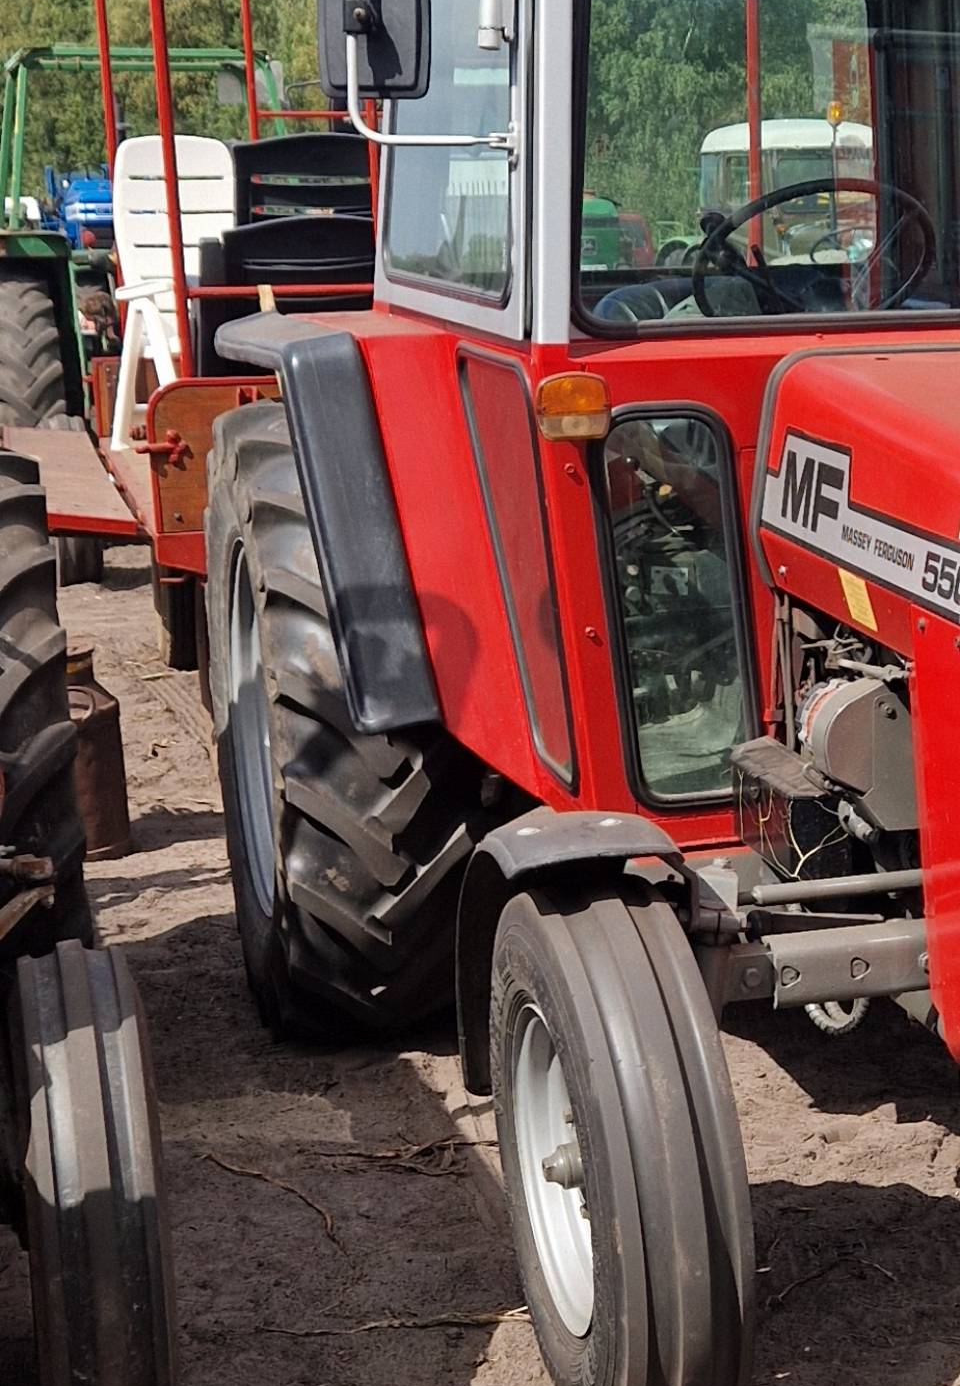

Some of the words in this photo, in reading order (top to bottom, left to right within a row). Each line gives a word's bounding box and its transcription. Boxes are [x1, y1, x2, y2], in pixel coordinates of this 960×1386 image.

[781, 449, 845, 533] MF
[841, 524, 873, 552] MASSEY
[873, 539, 916, 571] FERGUSON
